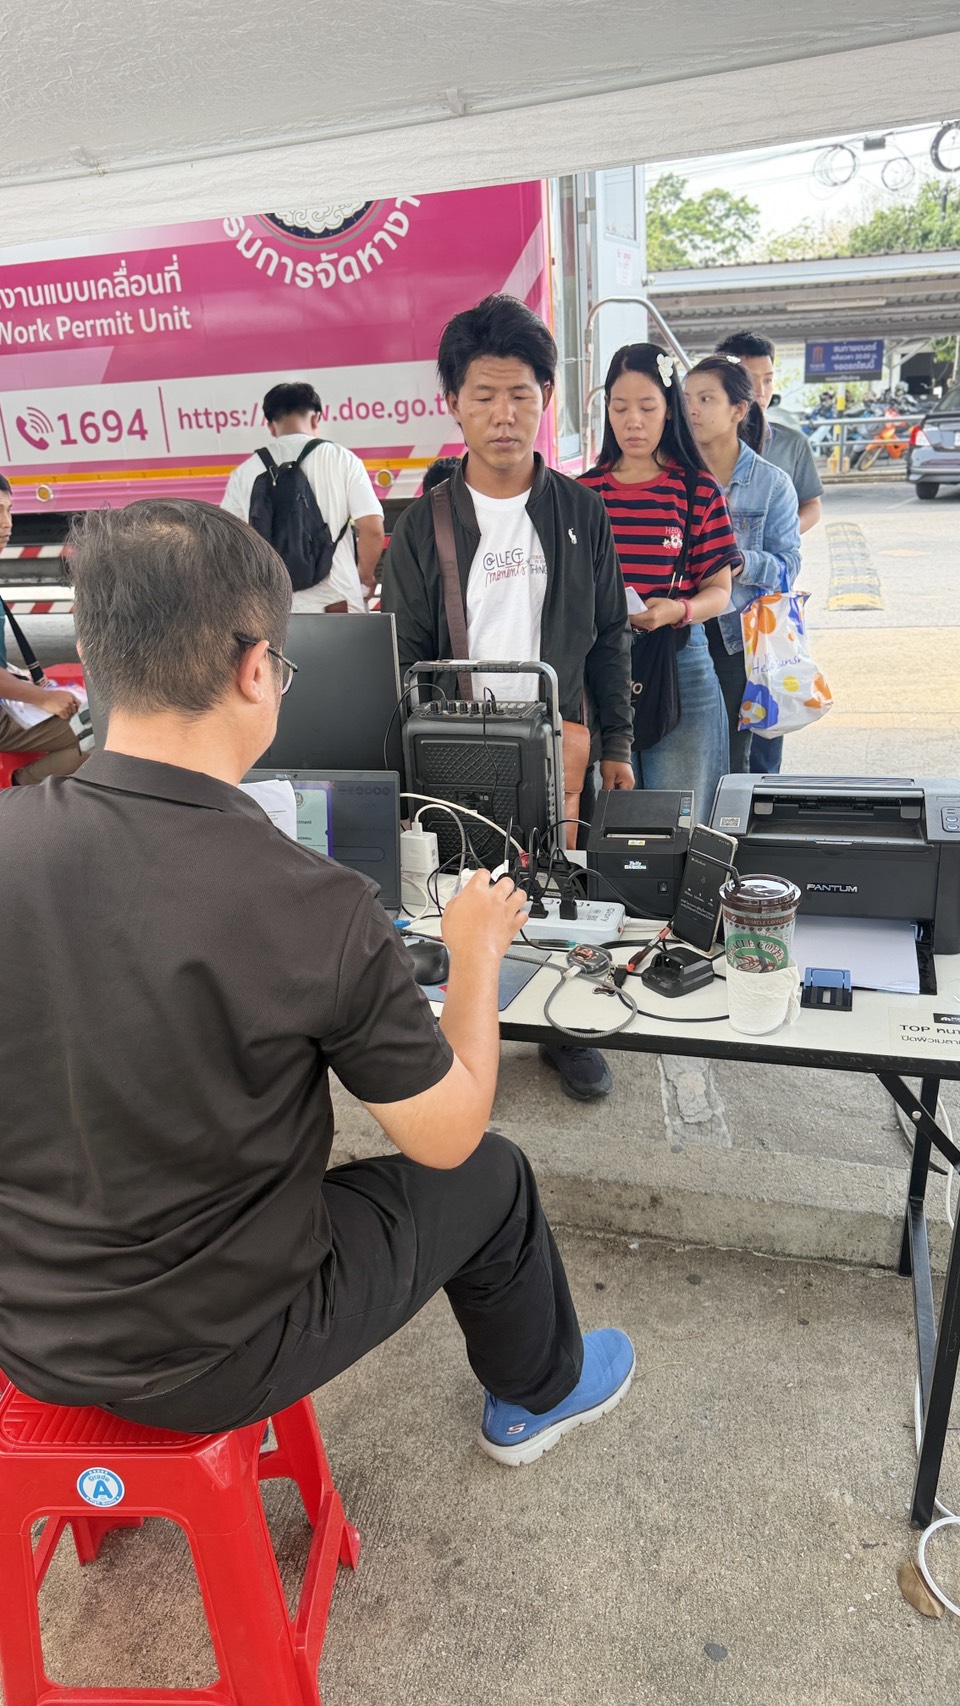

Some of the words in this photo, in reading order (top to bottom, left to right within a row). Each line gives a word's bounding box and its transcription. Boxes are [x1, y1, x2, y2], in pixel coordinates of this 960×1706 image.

[0, 254, 182, 309] งานแบบเคลื่อนที่
[56, 310, 134, 340] Permit
[138, 305, 192, 333] Unit
[57, 408, 149, 446] 1694
[806, 883, 858, 893] PANTUM
[899, 1024, 931, 1032] TOP
[93, 1480, 113, 1499] A
